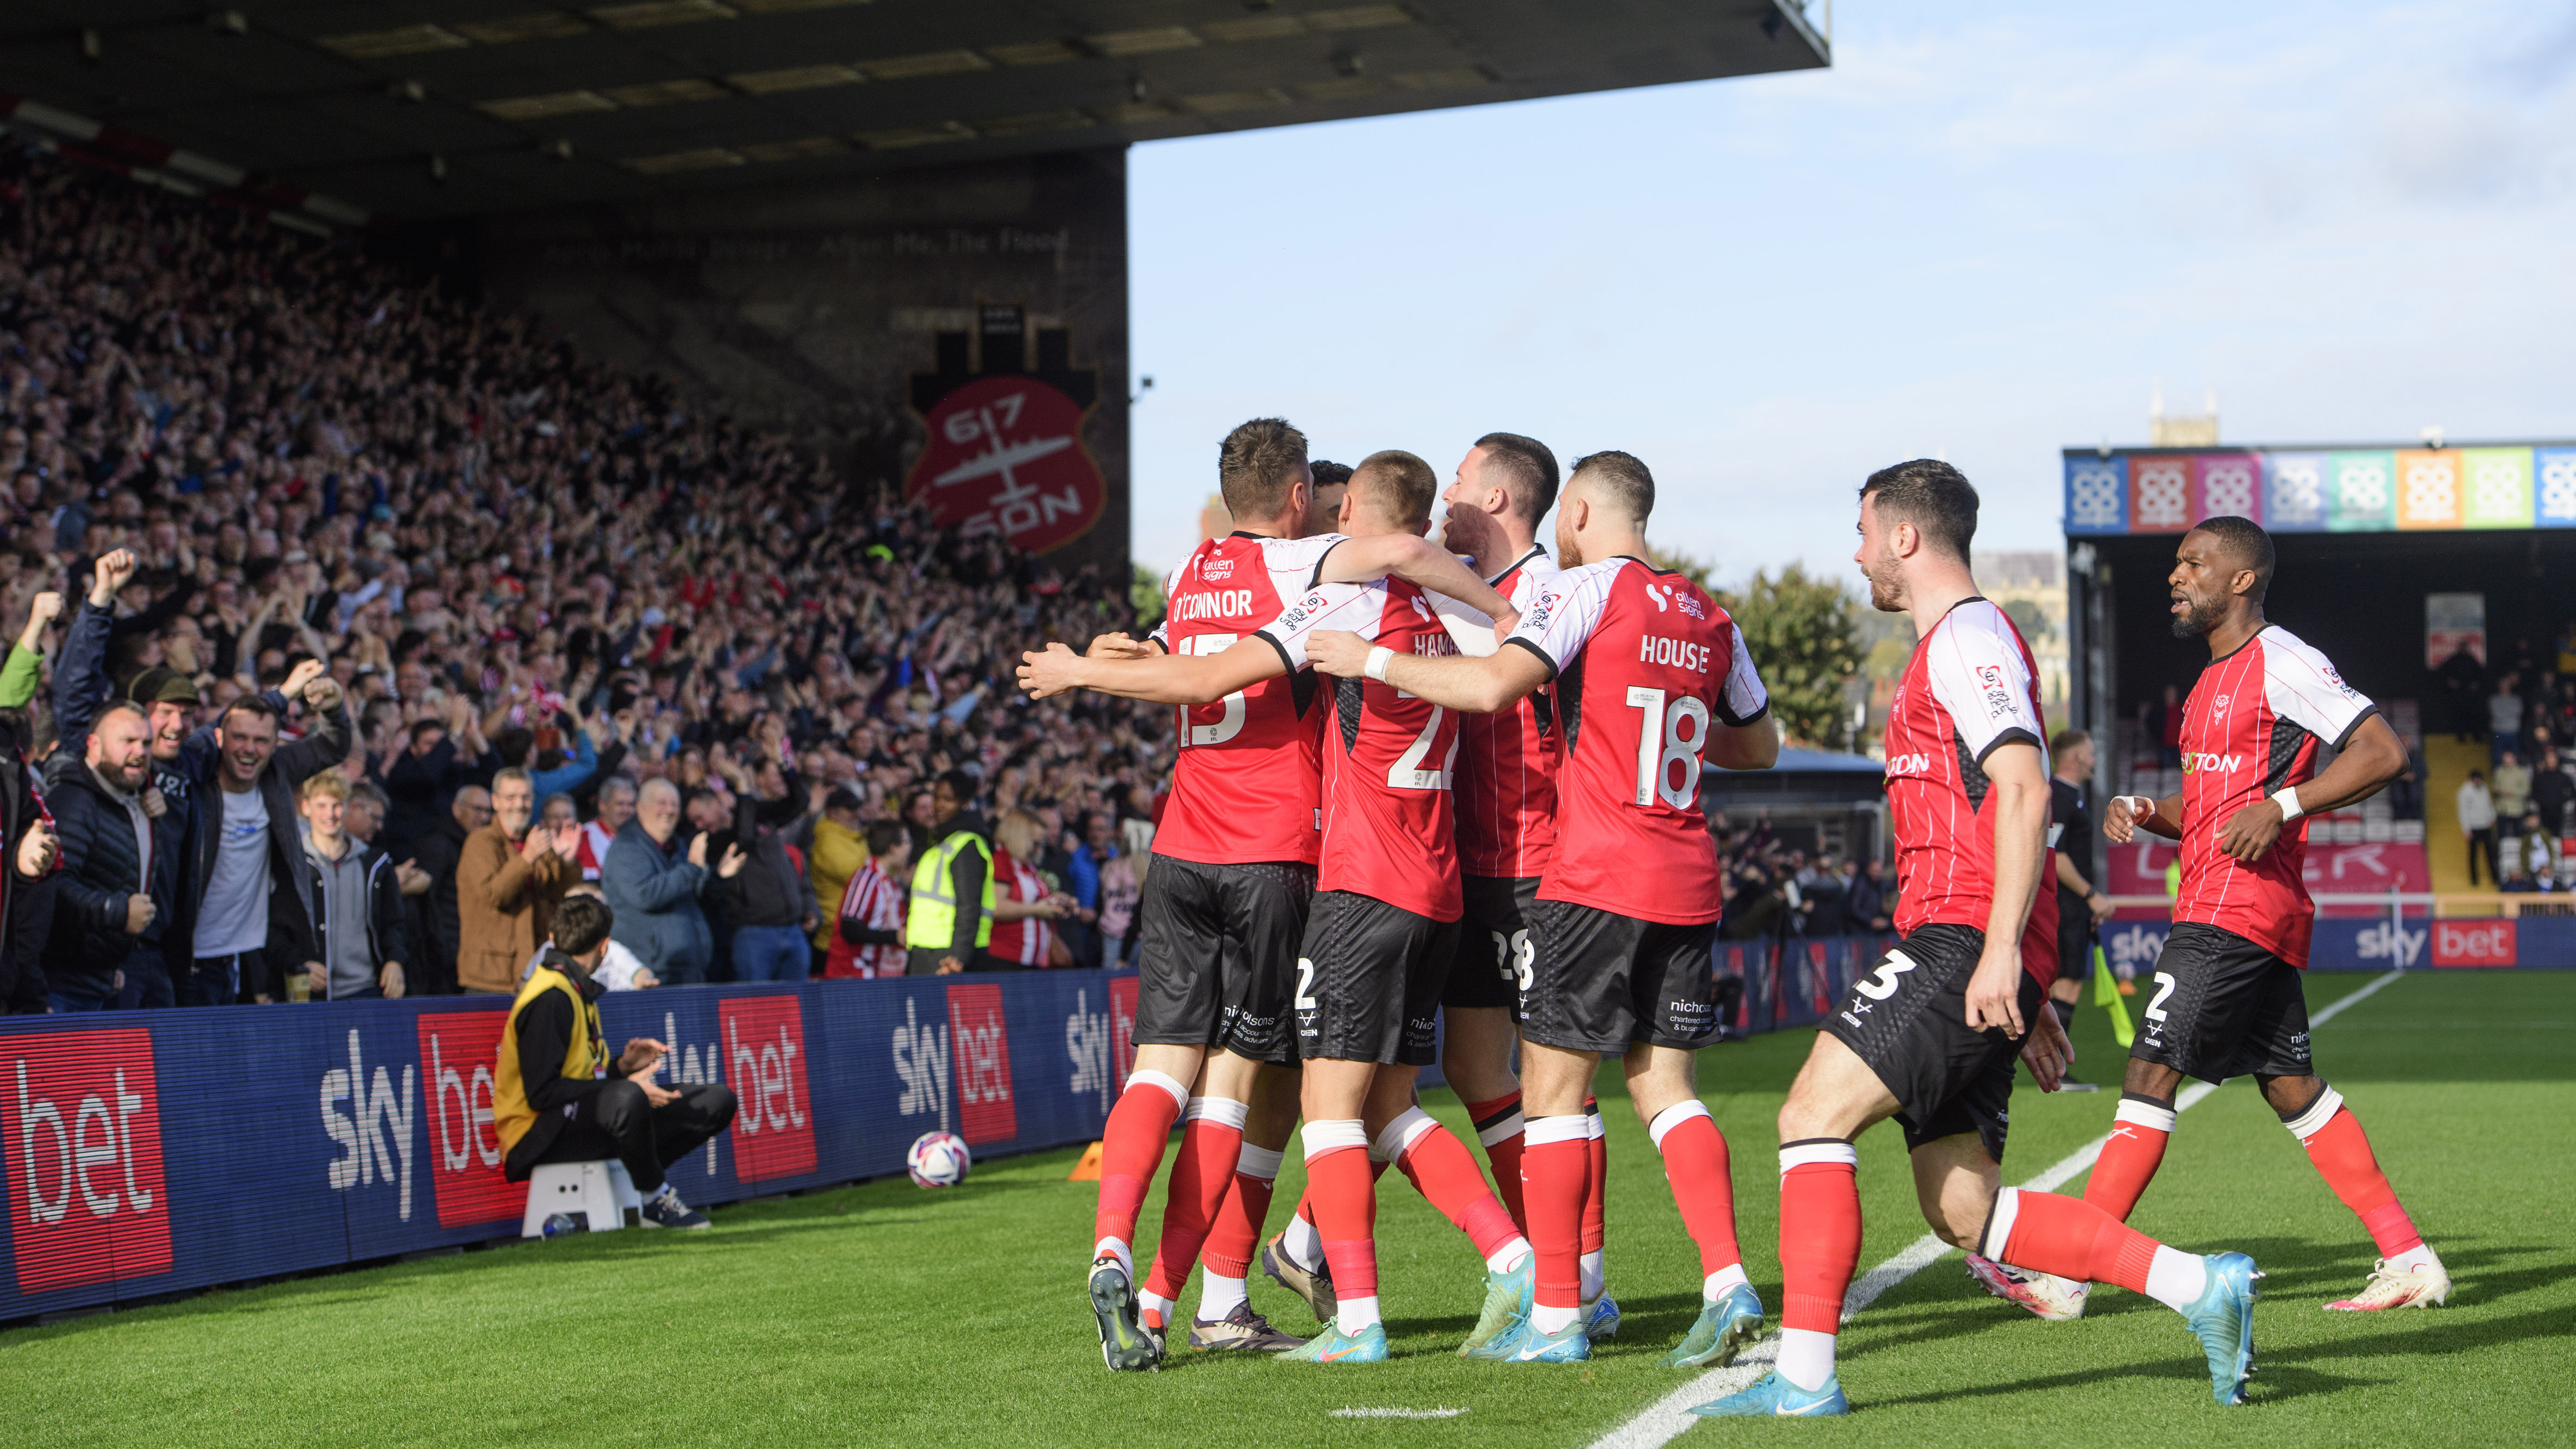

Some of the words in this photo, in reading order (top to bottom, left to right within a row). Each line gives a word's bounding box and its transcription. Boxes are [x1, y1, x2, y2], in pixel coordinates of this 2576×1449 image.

[943, 391, 1026, 445] 617
[1202, 571, 1232, 581] signs
[1676, 591, 1701, 610] allen
[1174, 590, 1252, 623] O'CONNOR
[1640, 634, 1711, 674] HOUSE
[1626, 685, 1709, 810] 18
[2438, 924, 2509, 958] bet
[2145, 971, 2176, 1022] 2
[729, 1015, 805, 1134] bet
[892, 996, 948, 1131] sky
[953, 1000, 1009, 1104] bet
[1067, 988, 1109, 1116] sky
[16, 1059, 153, 1227] bet
[320, 1028, 414, 1222] sky
[431, 1033, 501, 1171] be
